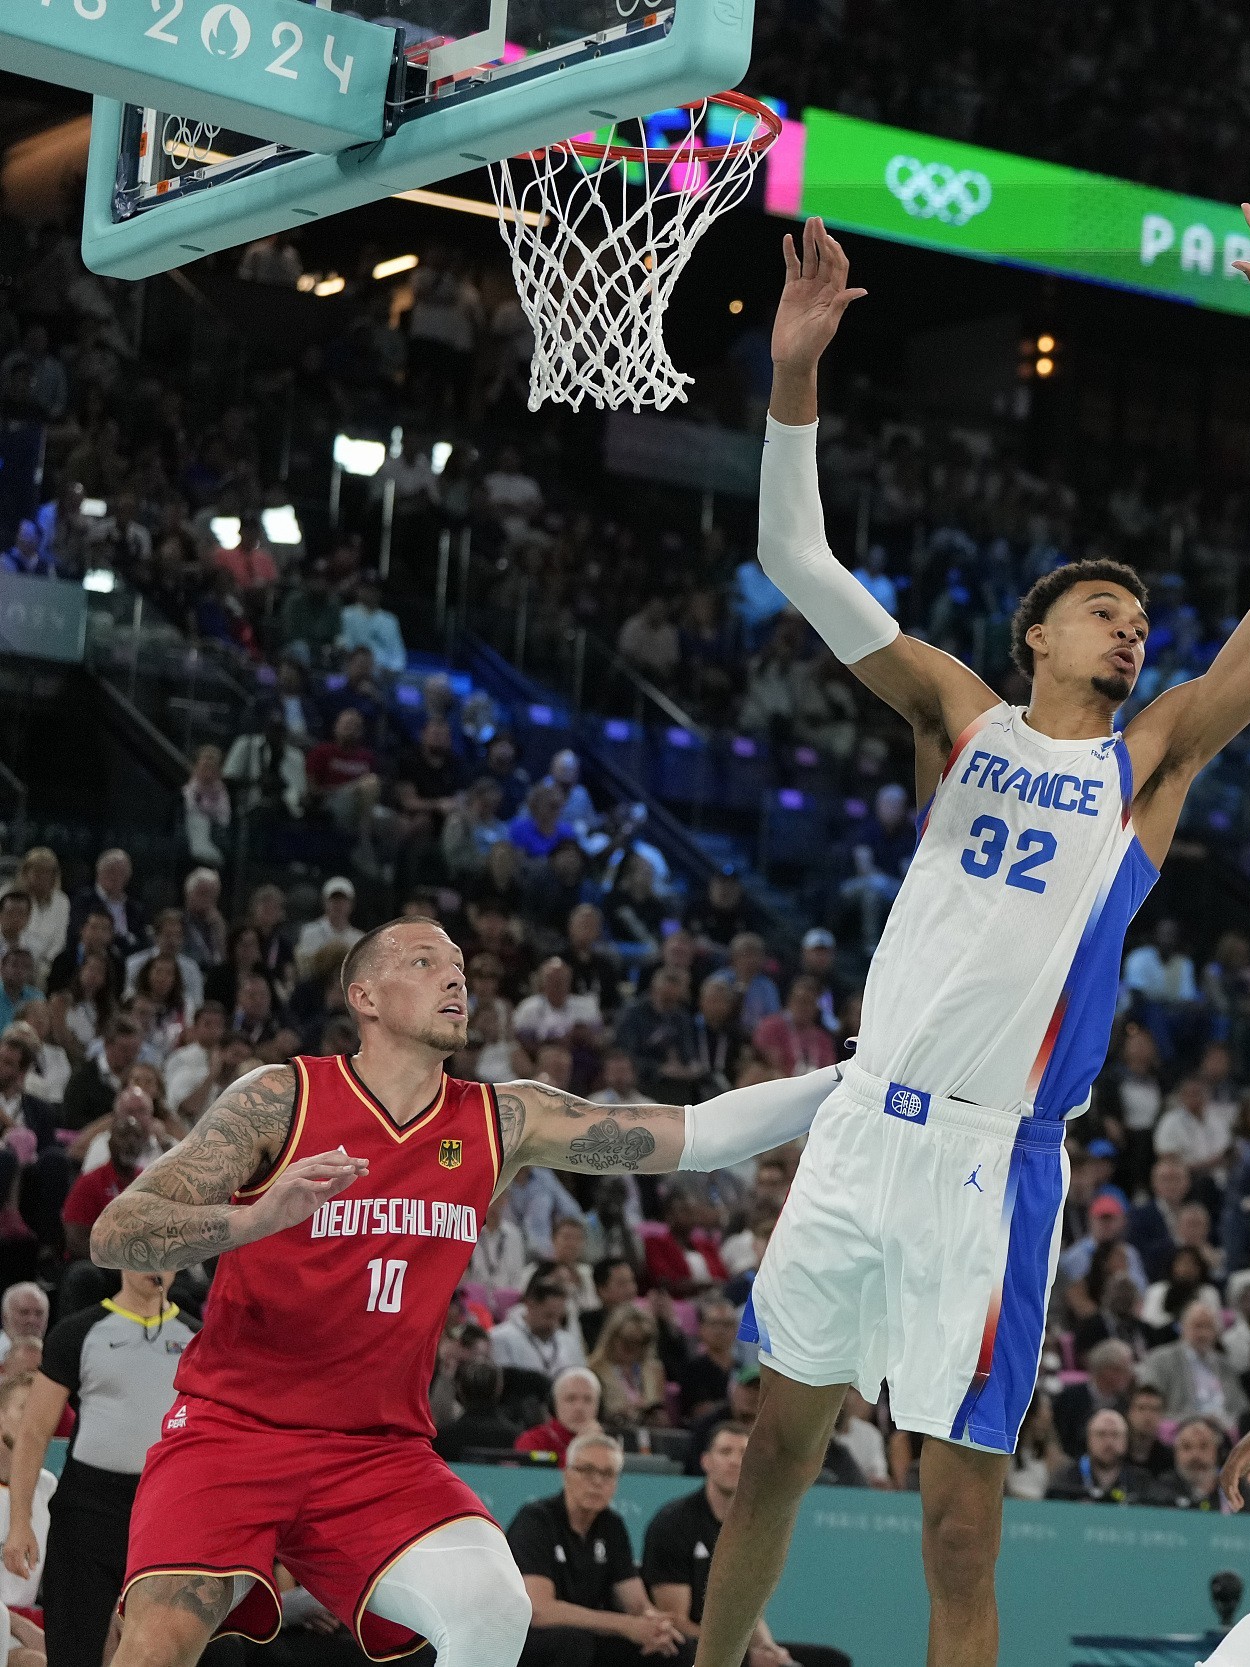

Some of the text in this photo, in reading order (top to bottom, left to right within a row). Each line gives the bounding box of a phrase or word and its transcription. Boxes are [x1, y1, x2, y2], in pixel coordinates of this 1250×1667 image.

[960, 750, 1104, 817] FRANCE
[960, 814, 1058, 895] 32
[311, 1198, 478, 1243] DEUTSCHLAND
[366, 1257, 408, 1313] 10
